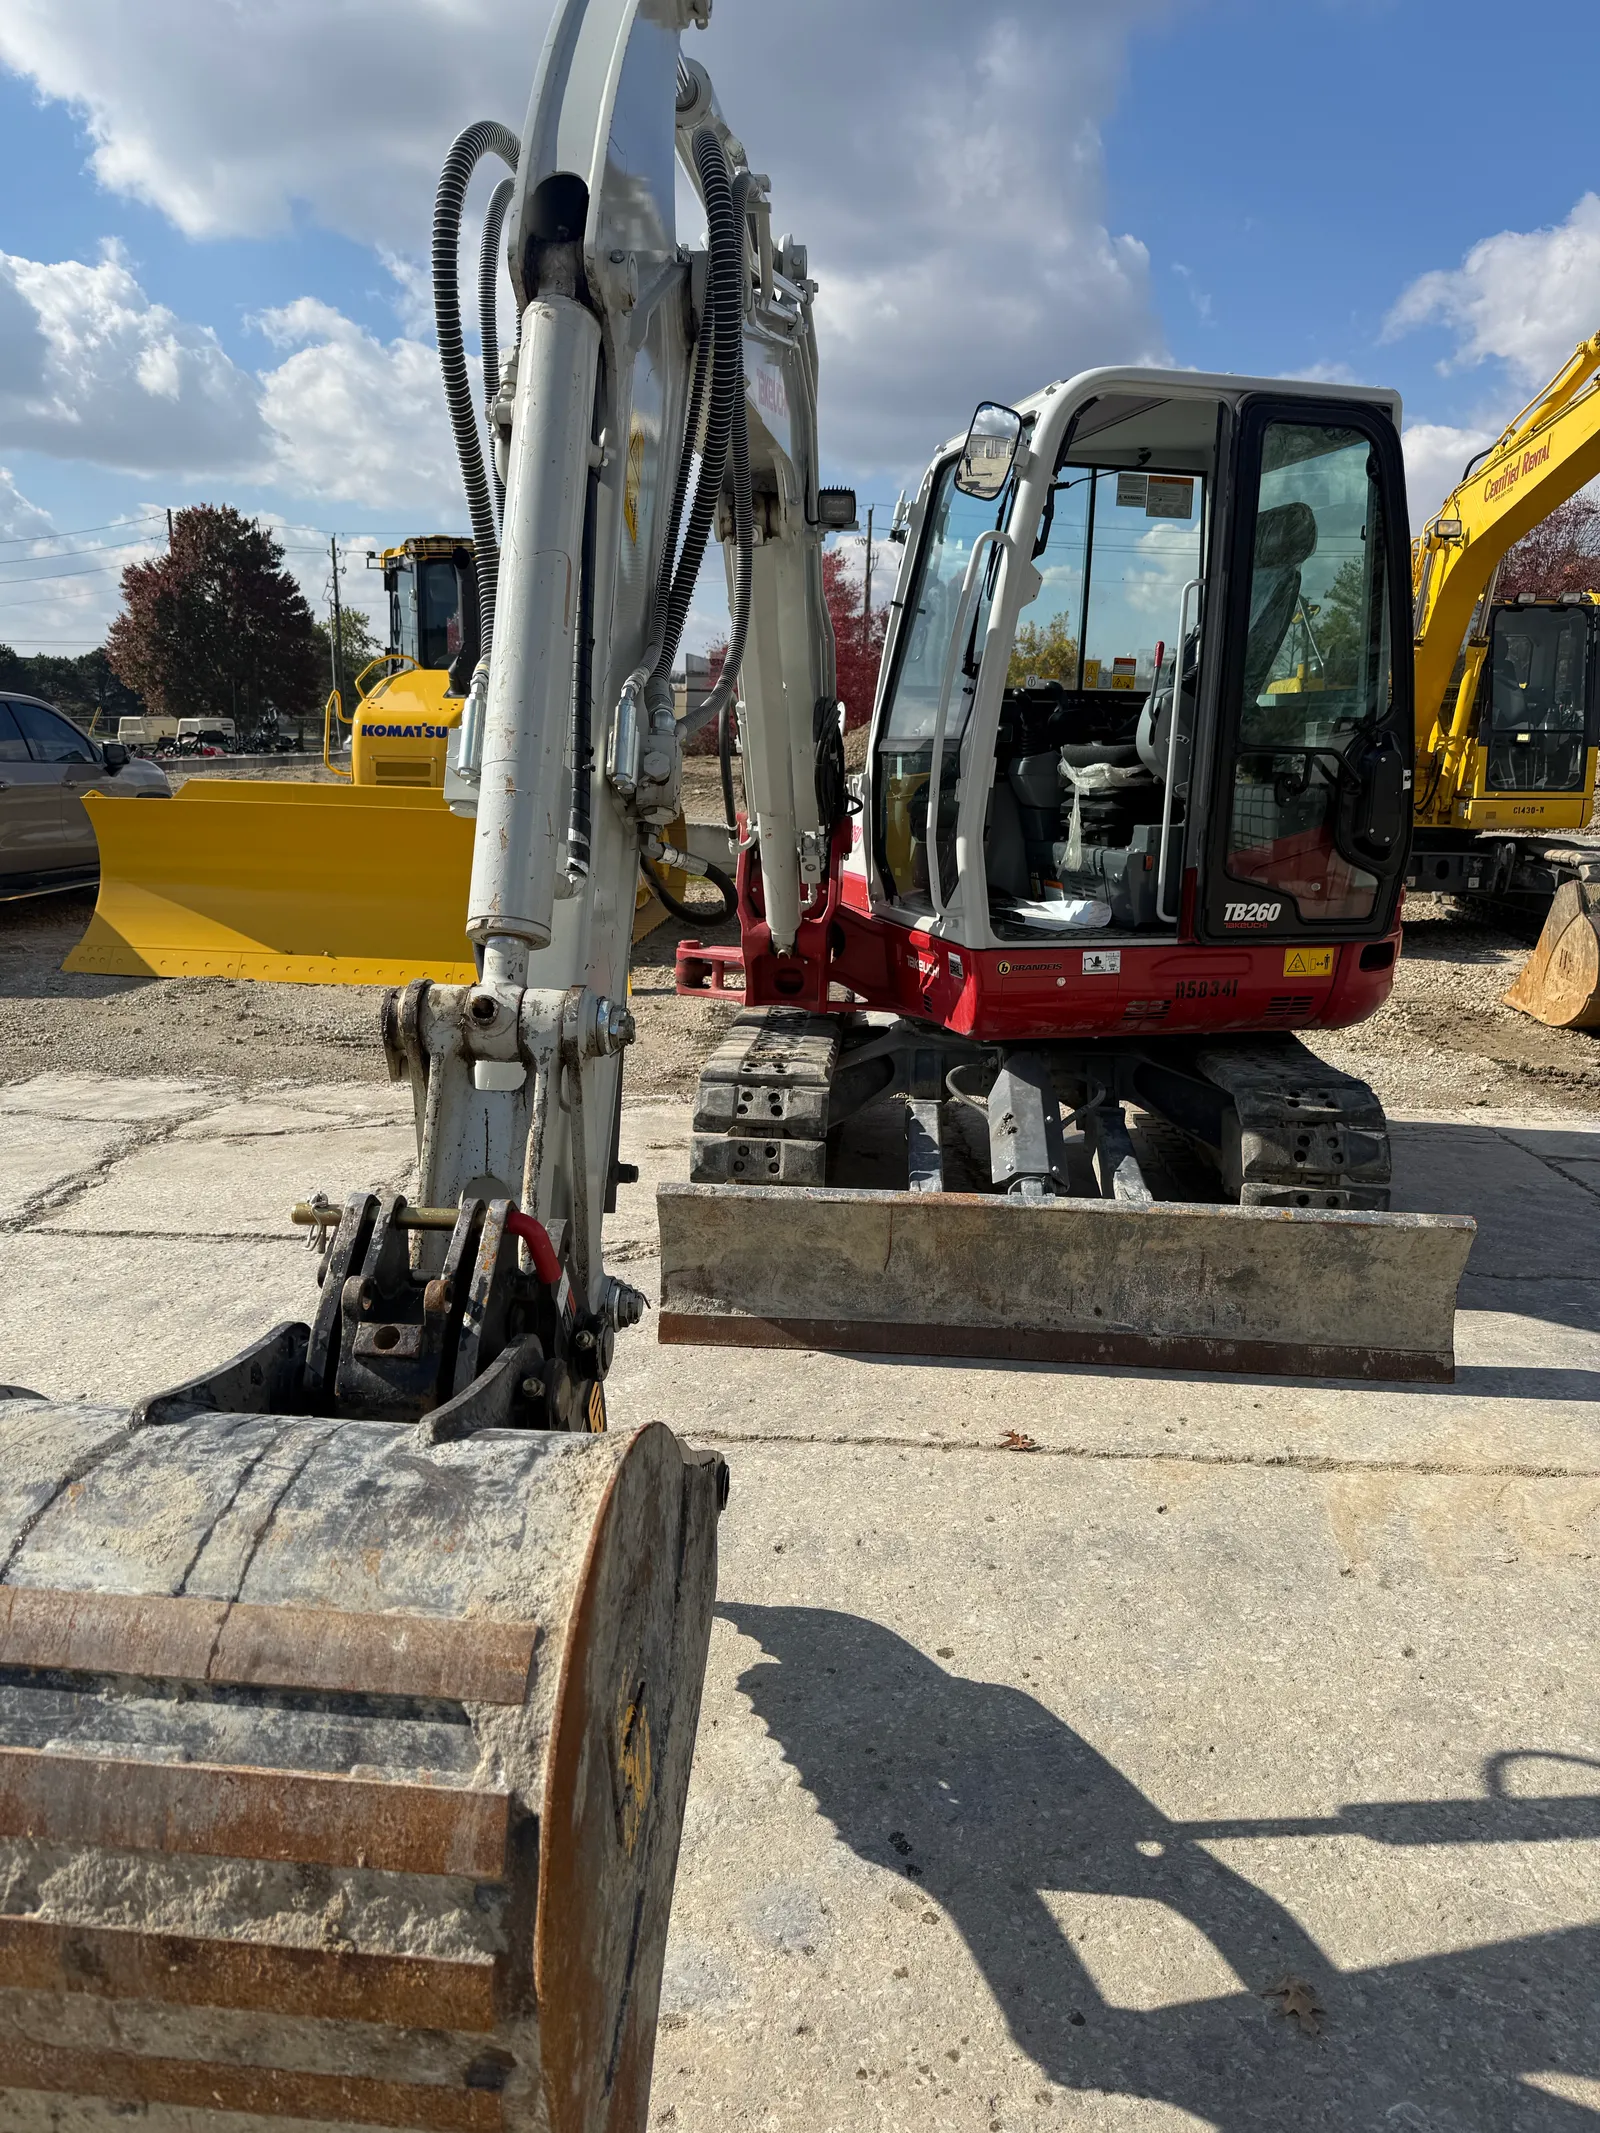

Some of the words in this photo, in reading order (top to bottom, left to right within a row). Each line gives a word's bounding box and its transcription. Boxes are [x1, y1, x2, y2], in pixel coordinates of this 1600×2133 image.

[361, 722, 448, 739] KOMATSU
[1223, 902, 1282, 922] TB260
[1012, 963, 1063, 972] BRANDEIS
